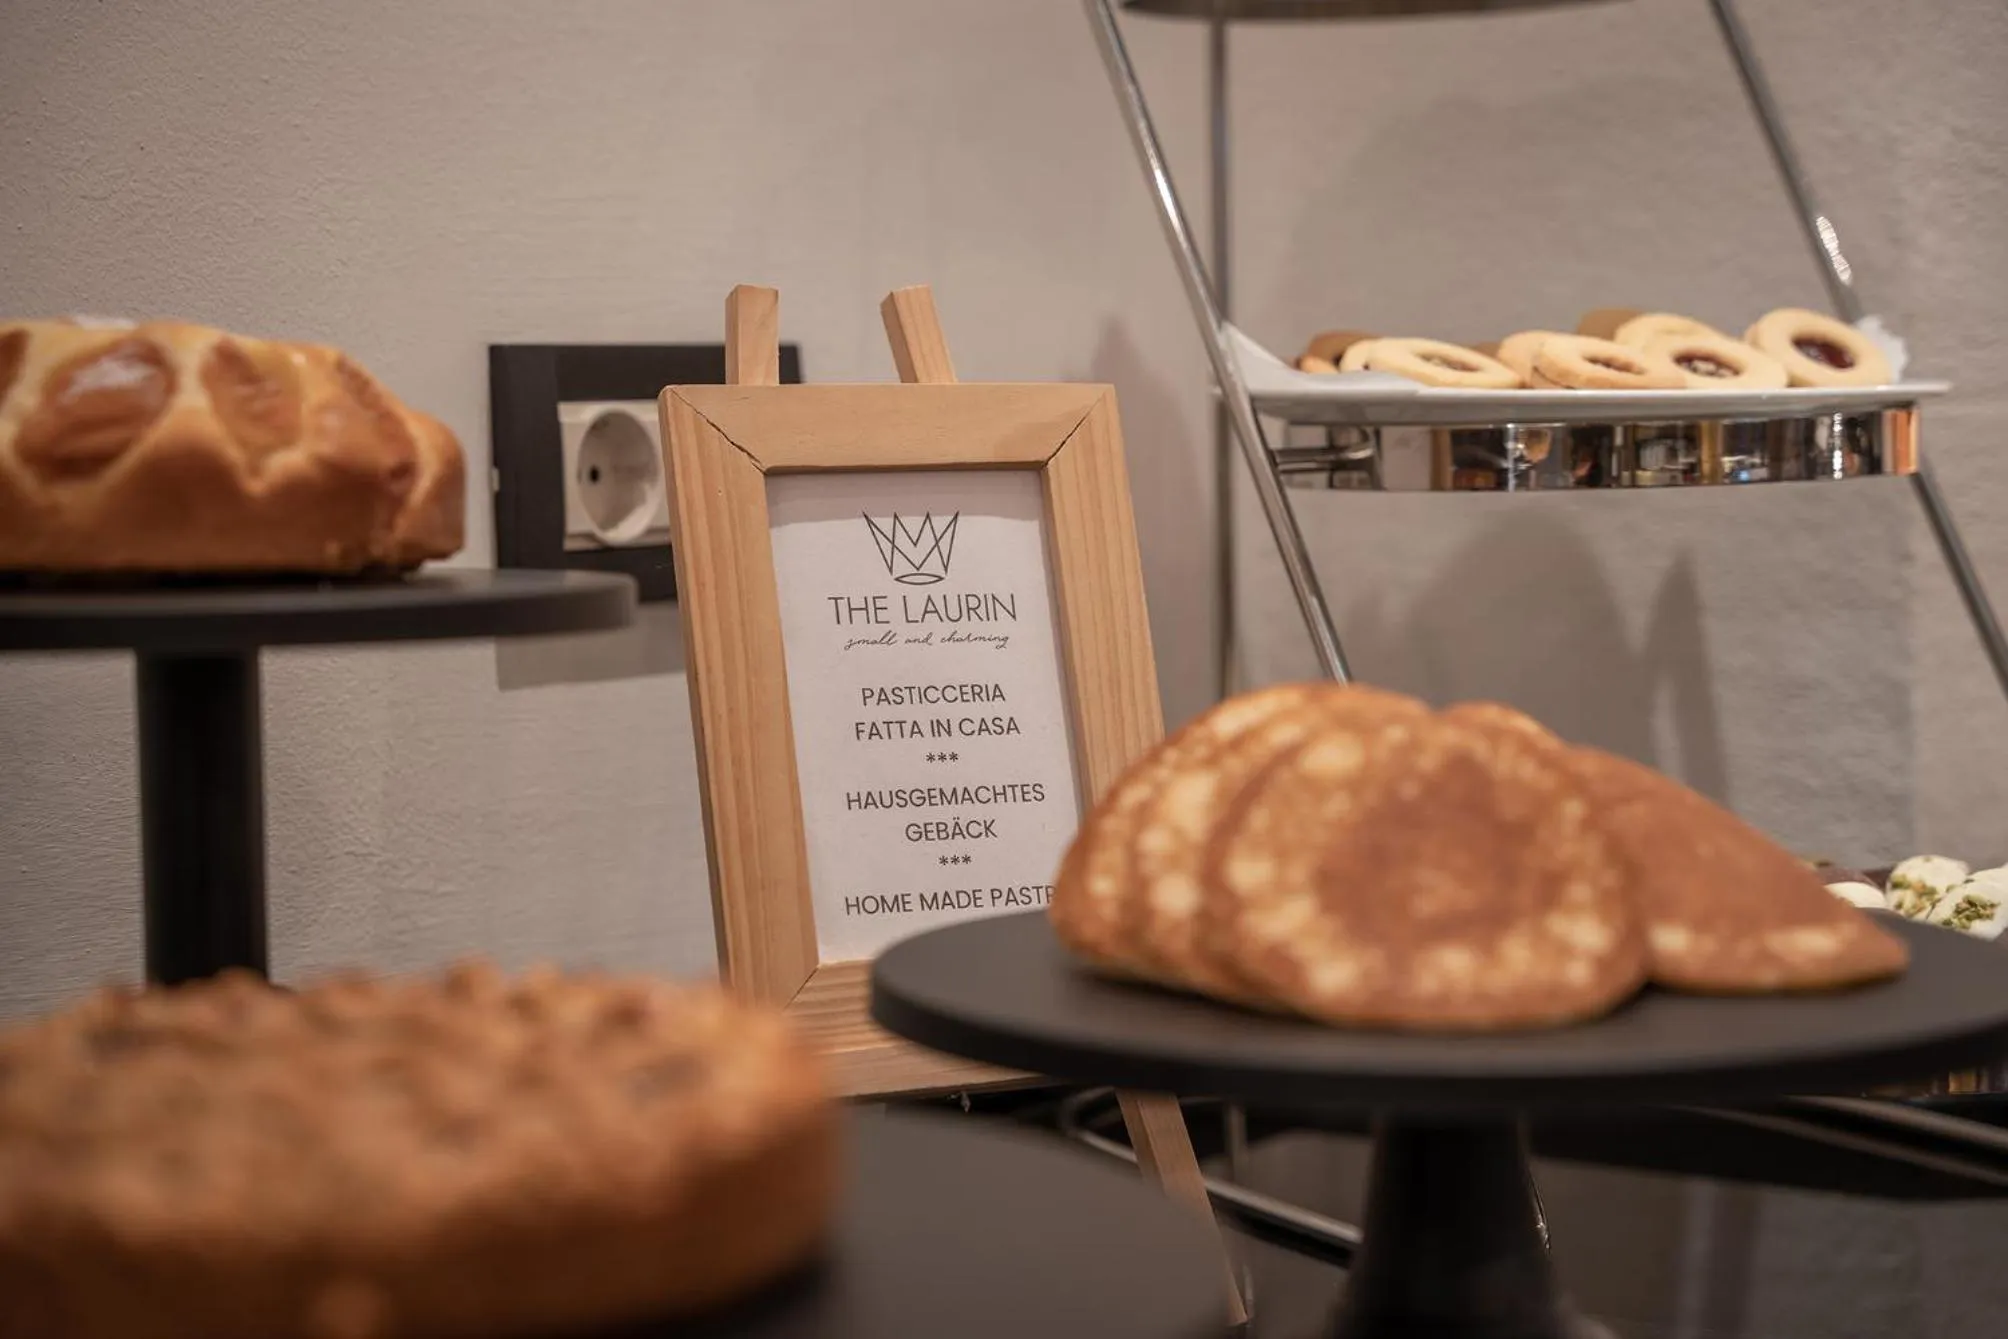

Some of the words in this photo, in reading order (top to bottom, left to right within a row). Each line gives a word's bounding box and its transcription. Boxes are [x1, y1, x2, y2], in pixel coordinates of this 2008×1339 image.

[828, 595, 890, 624] THE
[902, 593, 1017, 623] LAURIN
[844, 630, 897, 650] small
[904, 632, 932, 646] and
[940, 630, 1009, 649] charming
[861, 684, 1006, 706] PASTICCERIA
[855, 720, 924, 741] FATTA
[930, 718, 952, 737] IN
[959, 717, 1021, 736] CASA
[846, 783, 1045, 810] HAUSGEMACHTES
[905, 818, 997, 842] GEBÄCK
[845, 893, 913, 916] HOME
[919, 889, 984, 912] MADE
